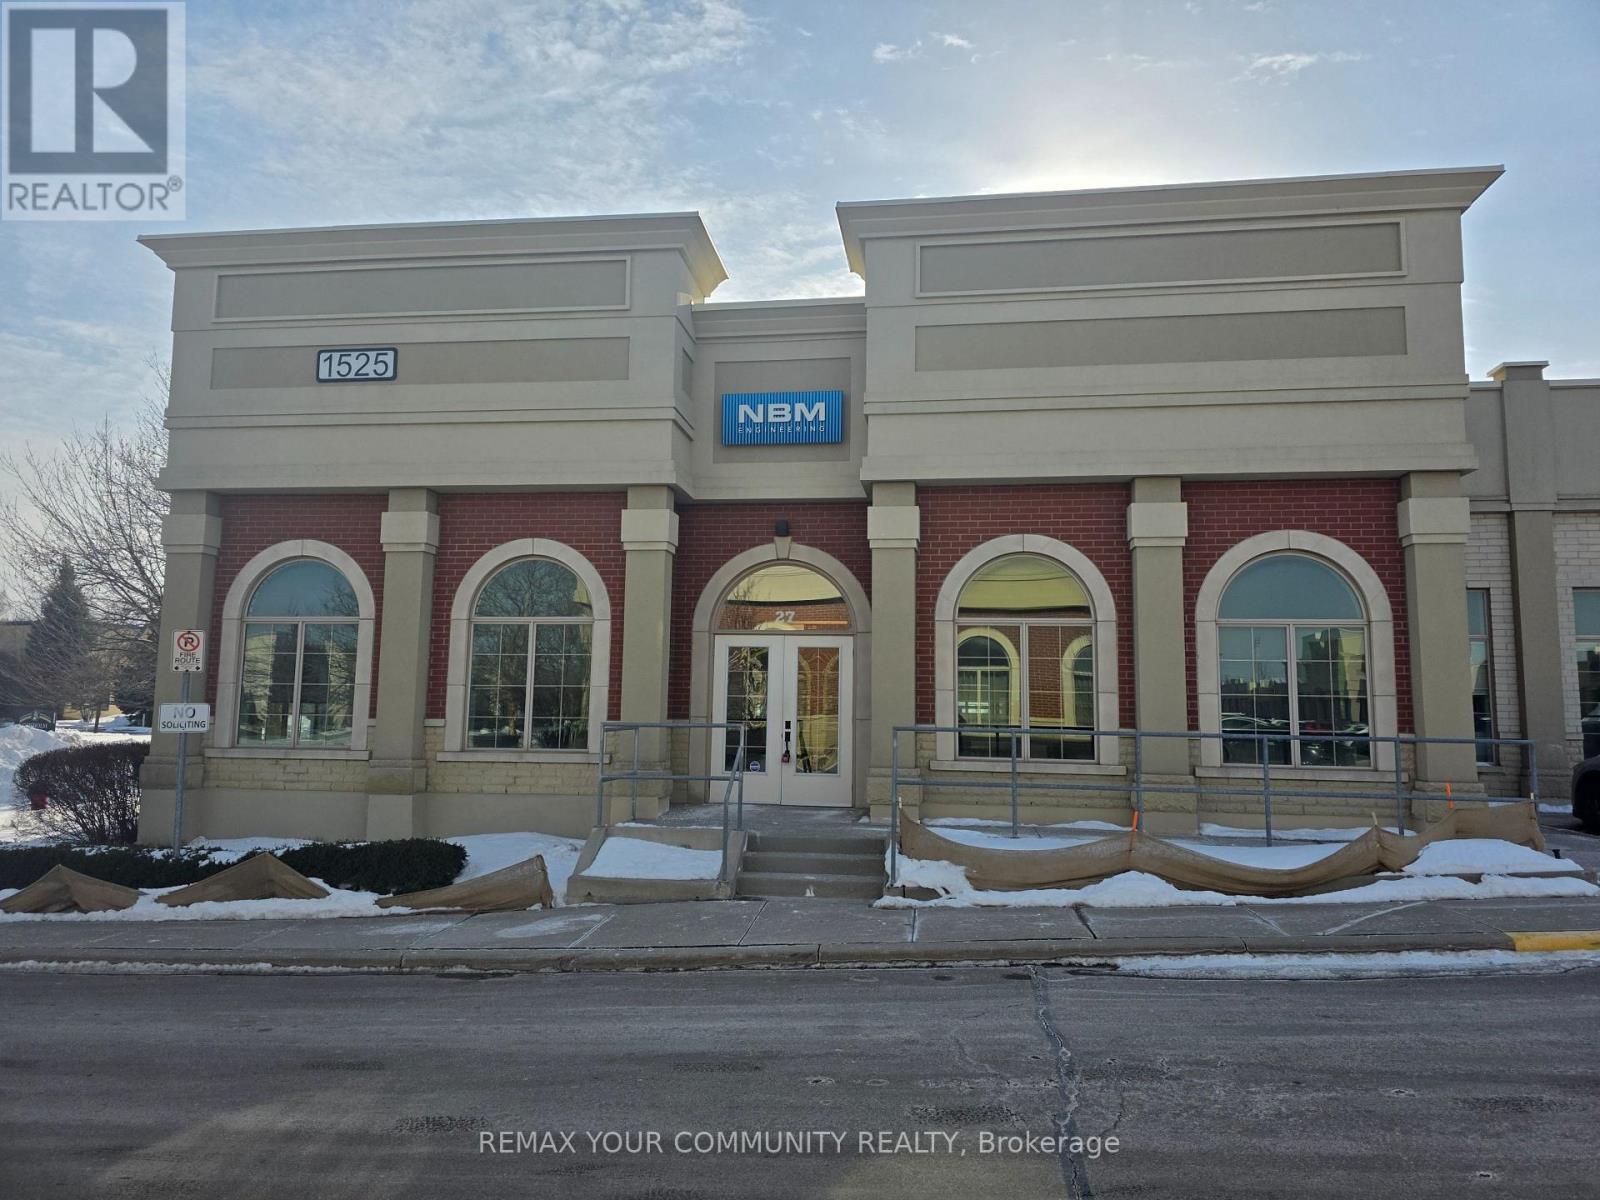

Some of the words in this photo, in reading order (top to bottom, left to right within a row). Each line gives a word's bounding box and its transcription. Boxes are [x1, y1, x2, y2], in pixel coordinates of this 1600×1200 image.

[323, 352, 389, 377] 1525
[738, 402, 826, 423] NBM
[738, 425, 825, 434] ENGINEERING
[775, 610, 796, 623] 27
[173, 706, 196, 719] NO
[161, 720, 206, 729] SOLICITING
